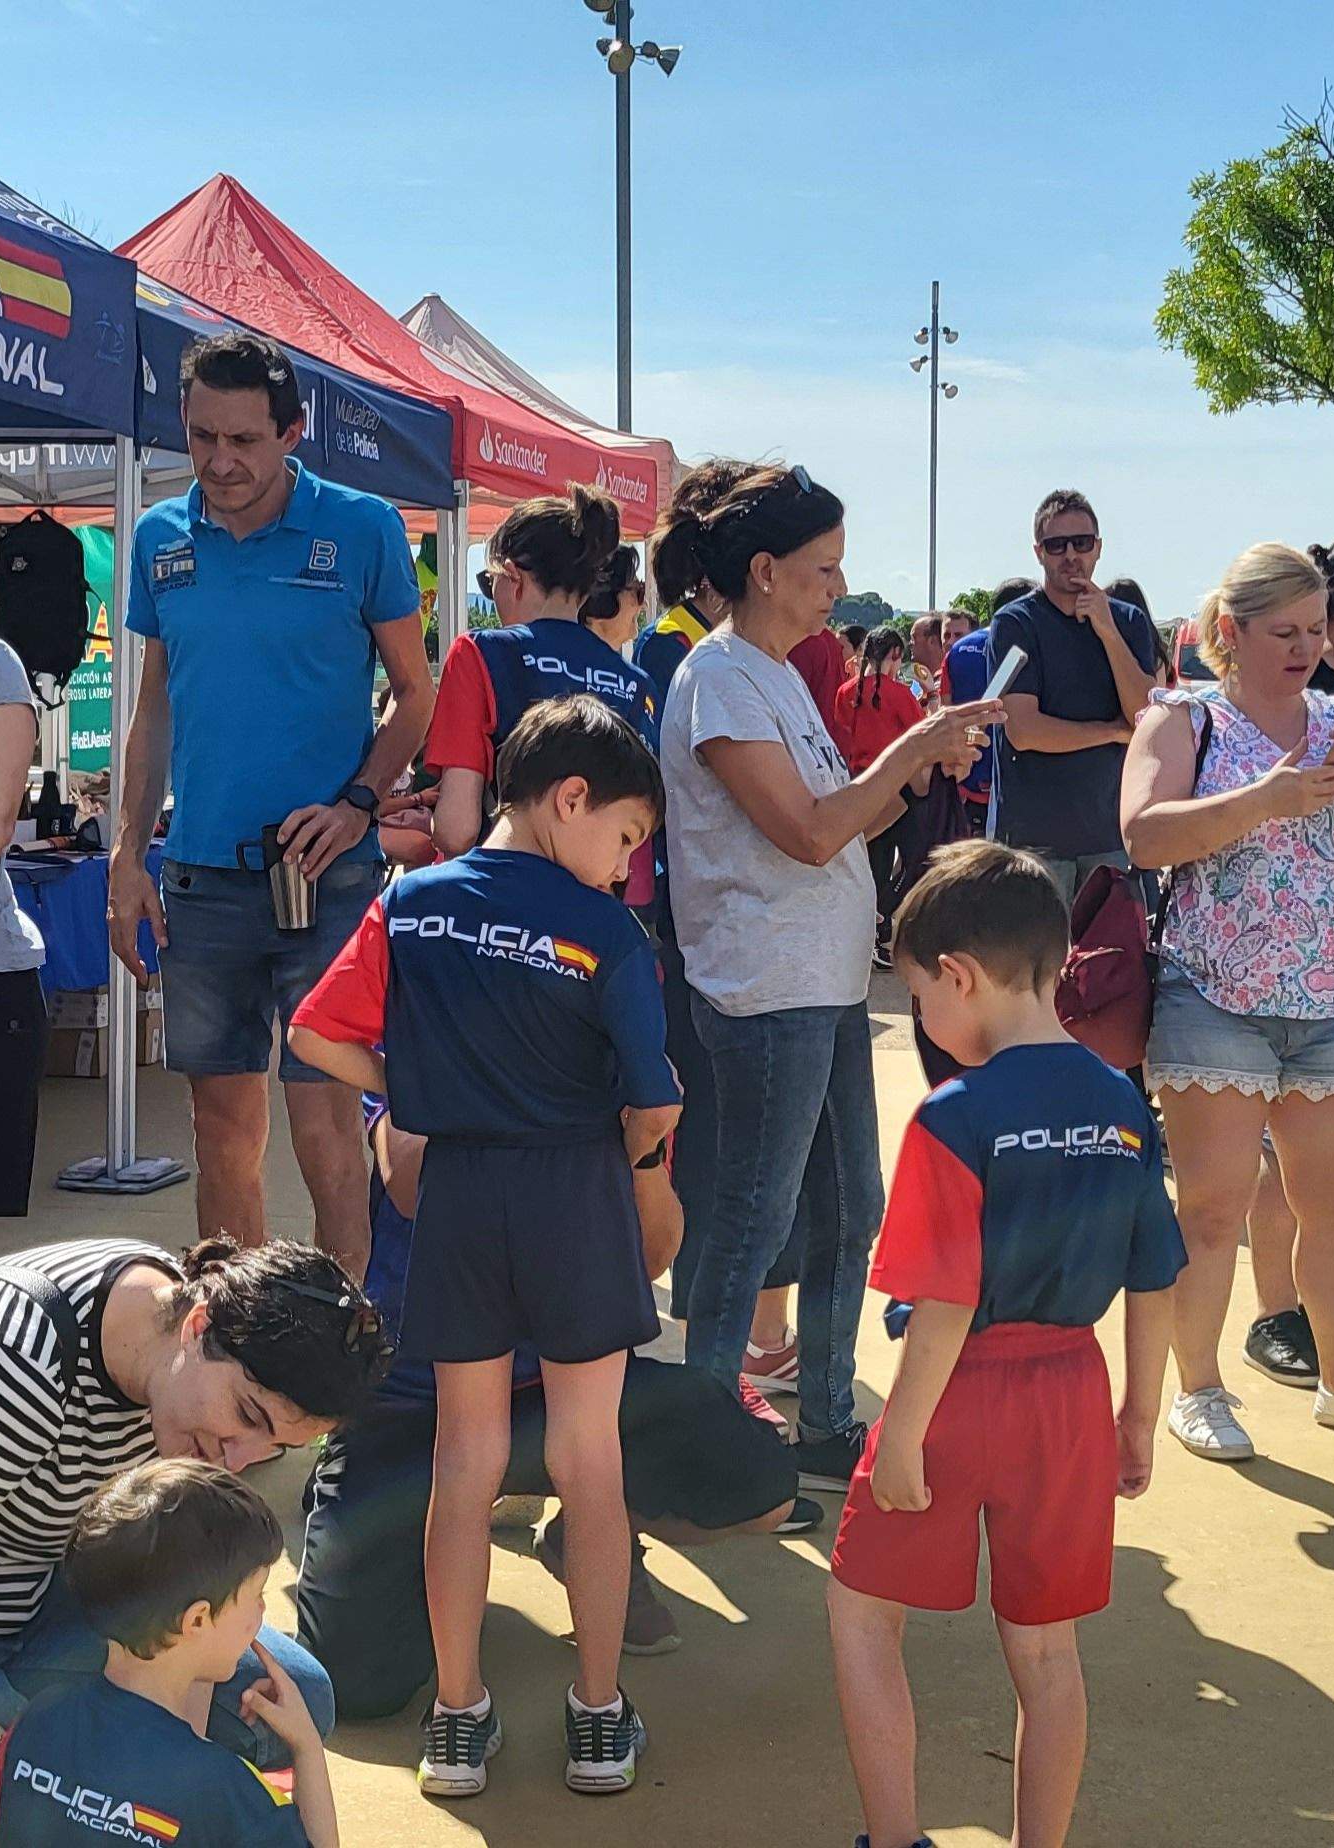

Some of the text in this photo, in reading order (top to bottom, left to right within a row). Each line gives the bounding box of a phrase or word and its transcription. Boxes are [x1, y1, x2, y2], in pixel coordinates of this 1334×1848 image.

[335, 394, 381, 432] Mutualidad
[335, 426, 347, 453] de
[354, 430, 380, 461] Policía
[495, 432, 548, 476] Santander
[607, 465, 649, 504] Santander
[476, 946, 590, 982] NACIONAL
